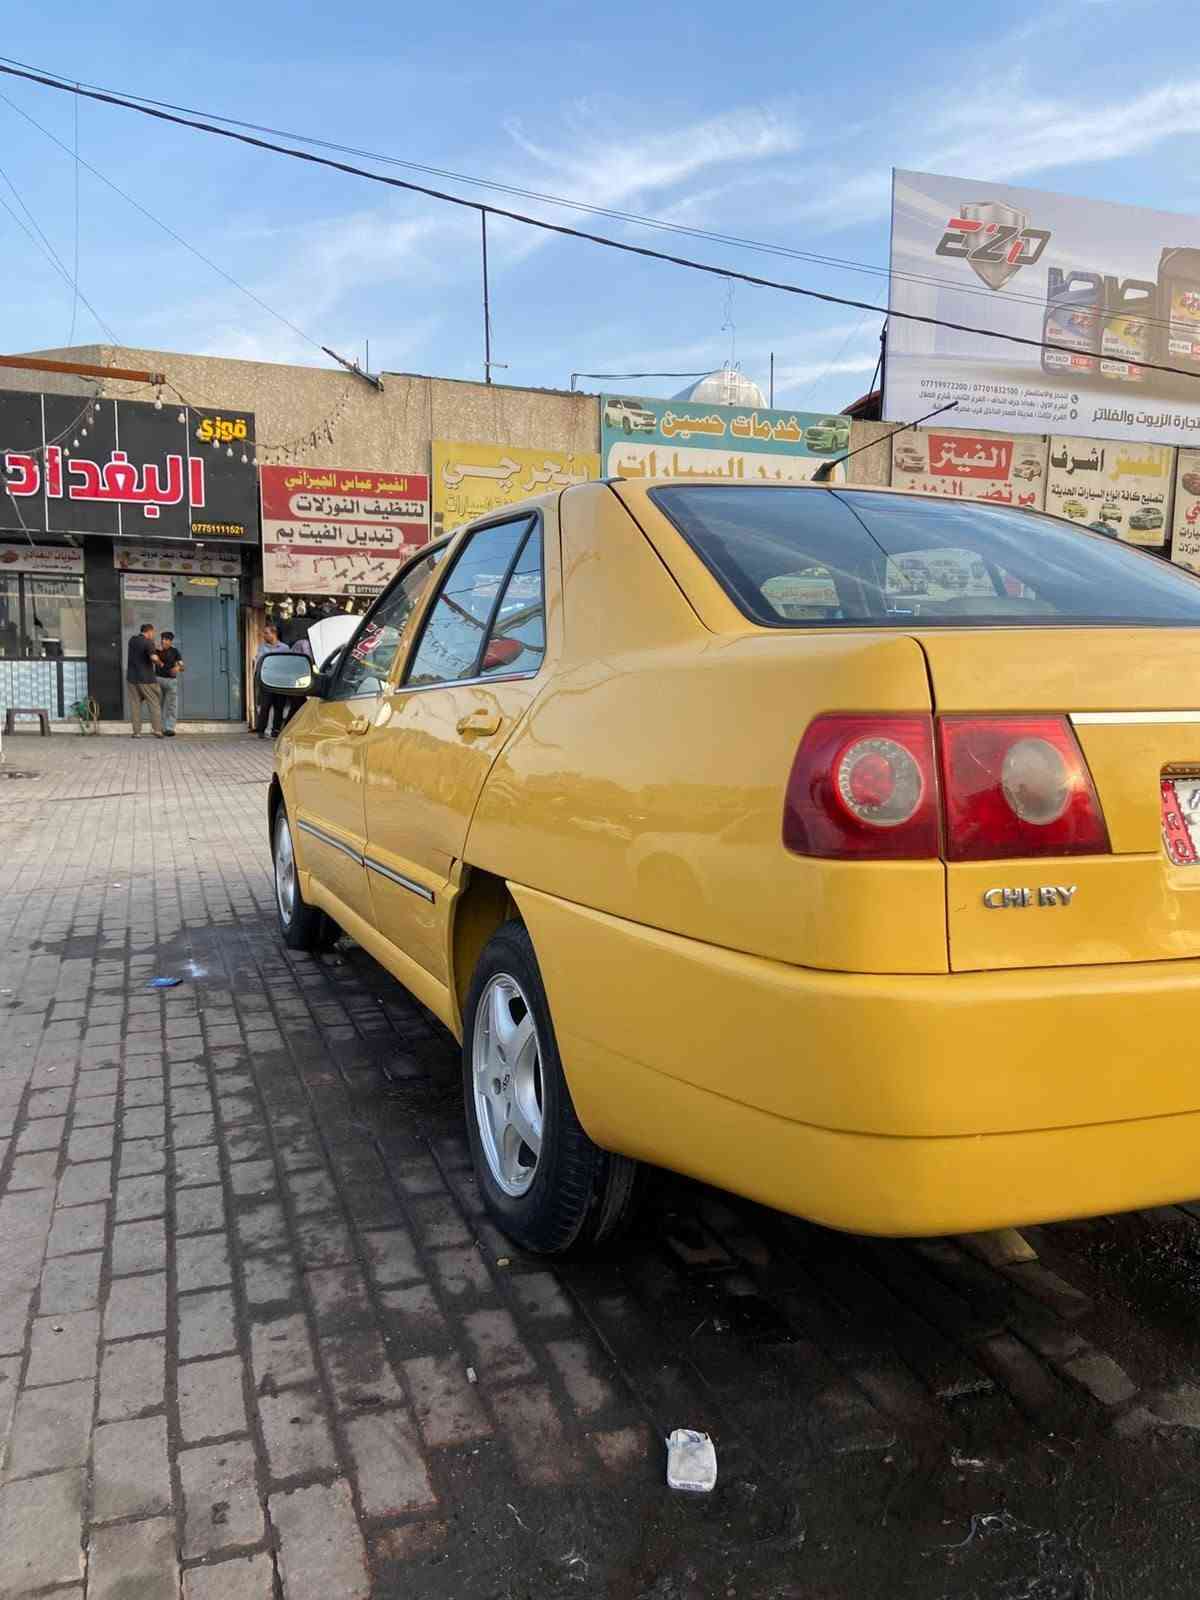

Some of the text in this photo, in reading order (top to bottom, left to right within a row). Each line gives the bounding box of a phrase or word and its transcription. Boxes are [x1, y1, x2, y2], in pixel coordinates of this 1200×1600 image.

[660, 410, 802, 442] خدمات حسين
[931, 441, 1007, 473] الفيتر
[339, 474, 373, 493] عباس
[296, 495, 425, 520] لتنظيف النوزلات
[299, 523, 343, 544] الفيت
[346, 527, 395, 547] تبديل
[983, 884, 1078, 909] CHERY
